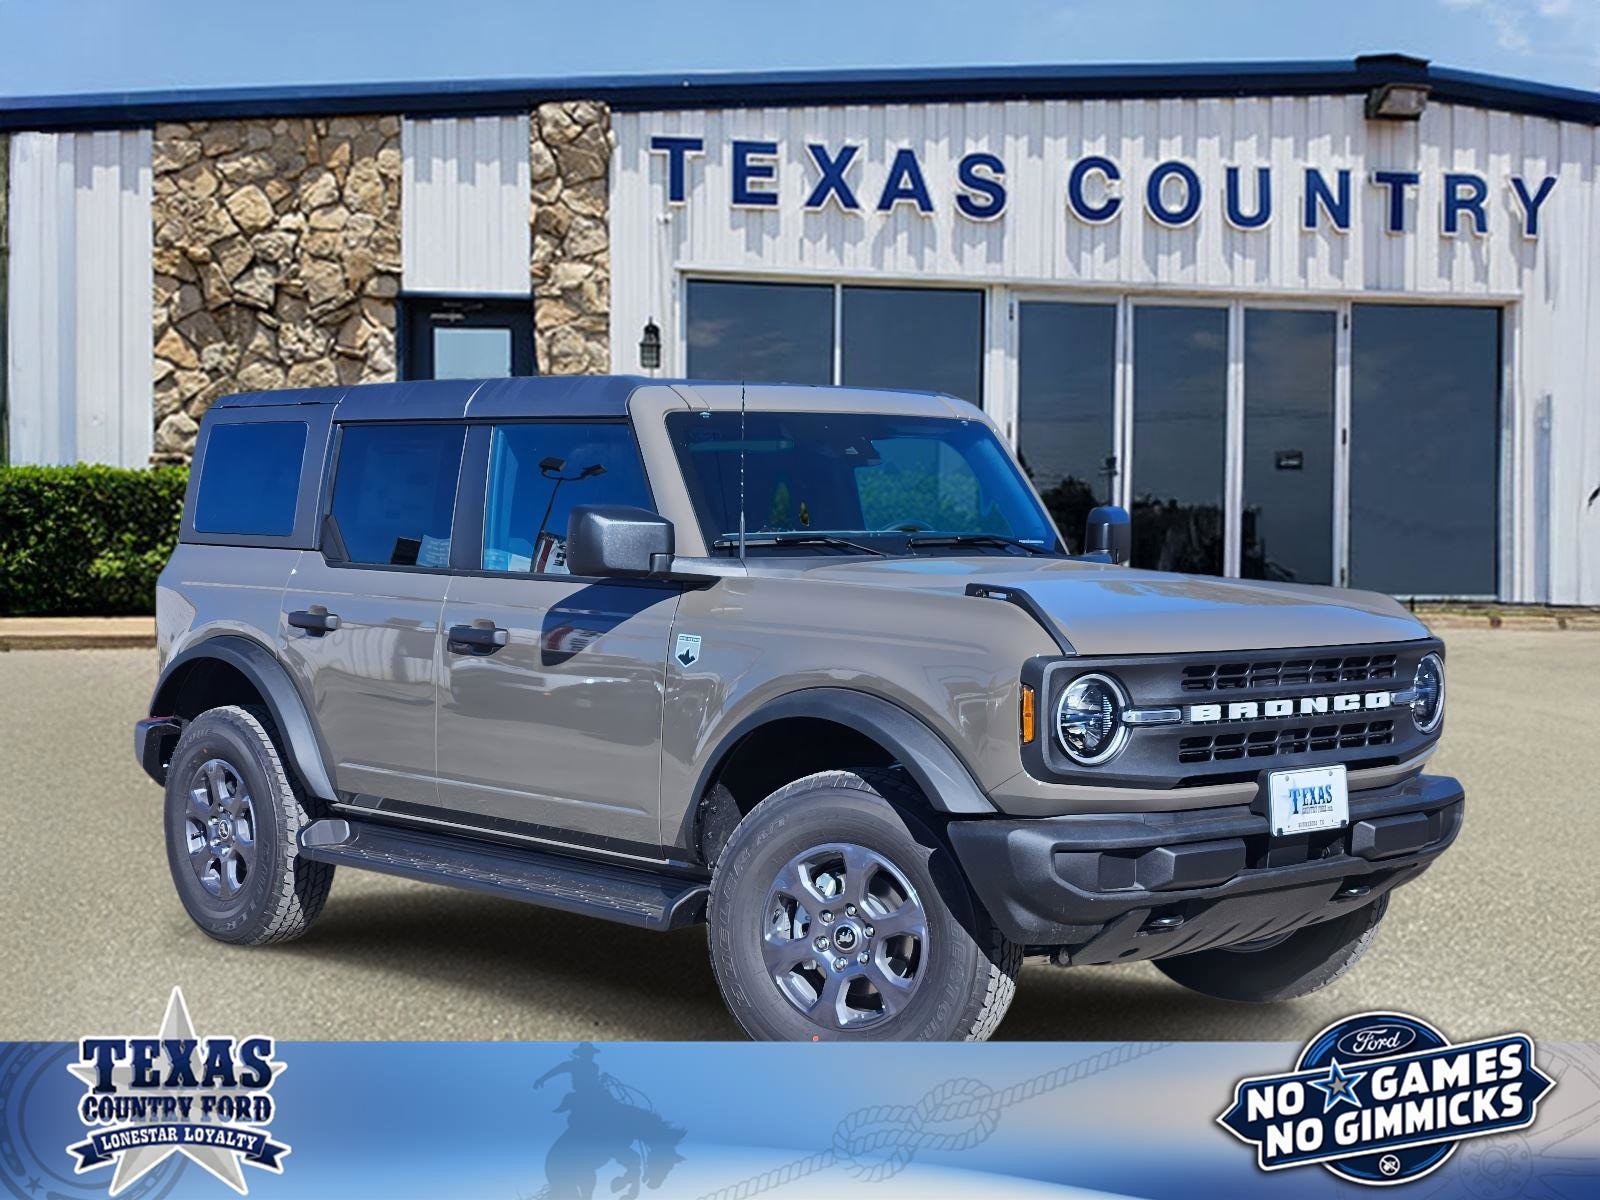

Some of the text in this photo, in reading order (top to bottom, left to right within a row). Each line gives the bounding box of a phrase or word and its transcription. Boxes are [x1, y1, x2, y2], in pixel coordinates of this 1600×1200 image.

[650, 134, 1556, 240] TEXAS COUNTRY
[1190, 691, 1391, 722] BRONCO
[1288, 784, 1334, 815] TEXAS
